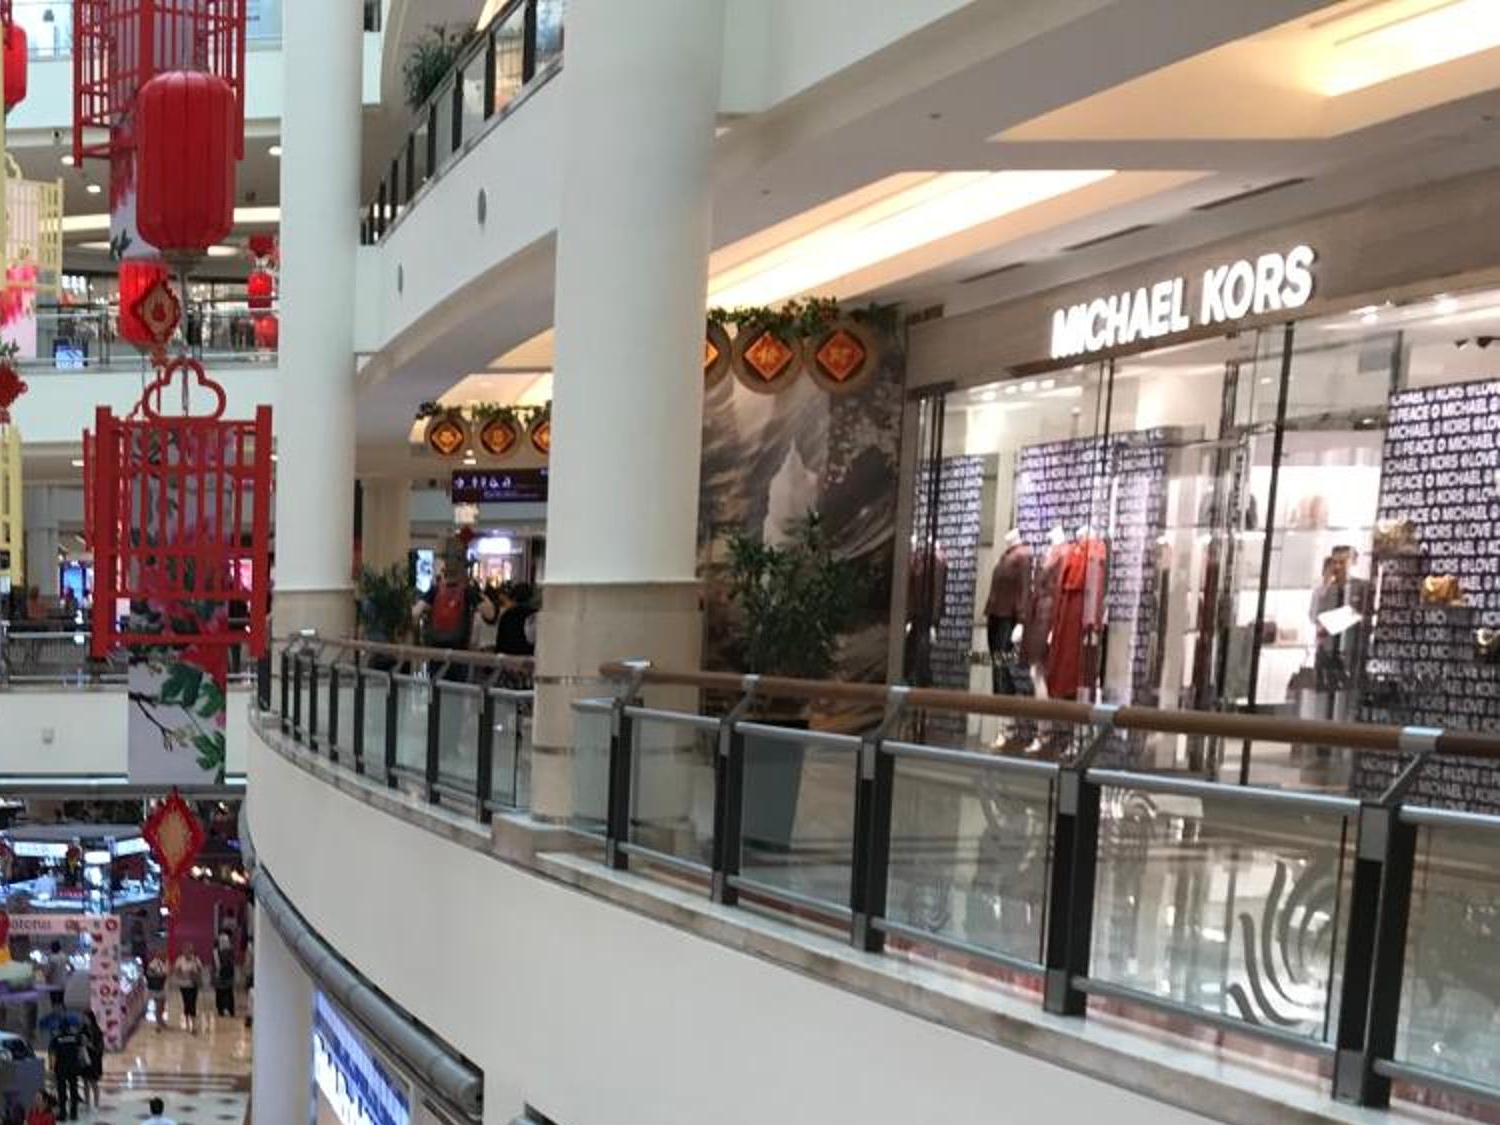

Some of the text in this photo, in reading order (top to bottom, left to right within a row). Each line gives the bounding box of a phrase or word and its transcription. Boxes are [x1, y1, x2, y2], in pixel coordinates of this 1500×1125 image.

[1051, 244, 1315, 359] MICHAEL KORS
[1442, 398, 1488, 416] MICHAEL
[1448, 432, 1494, 450] MICHAEL
[1435, 468, 1481, 486] MICHAEL
[1442, 503, 1488, 520] MICHAEL
[1431, 539, 1476, 555] MICHAEL
